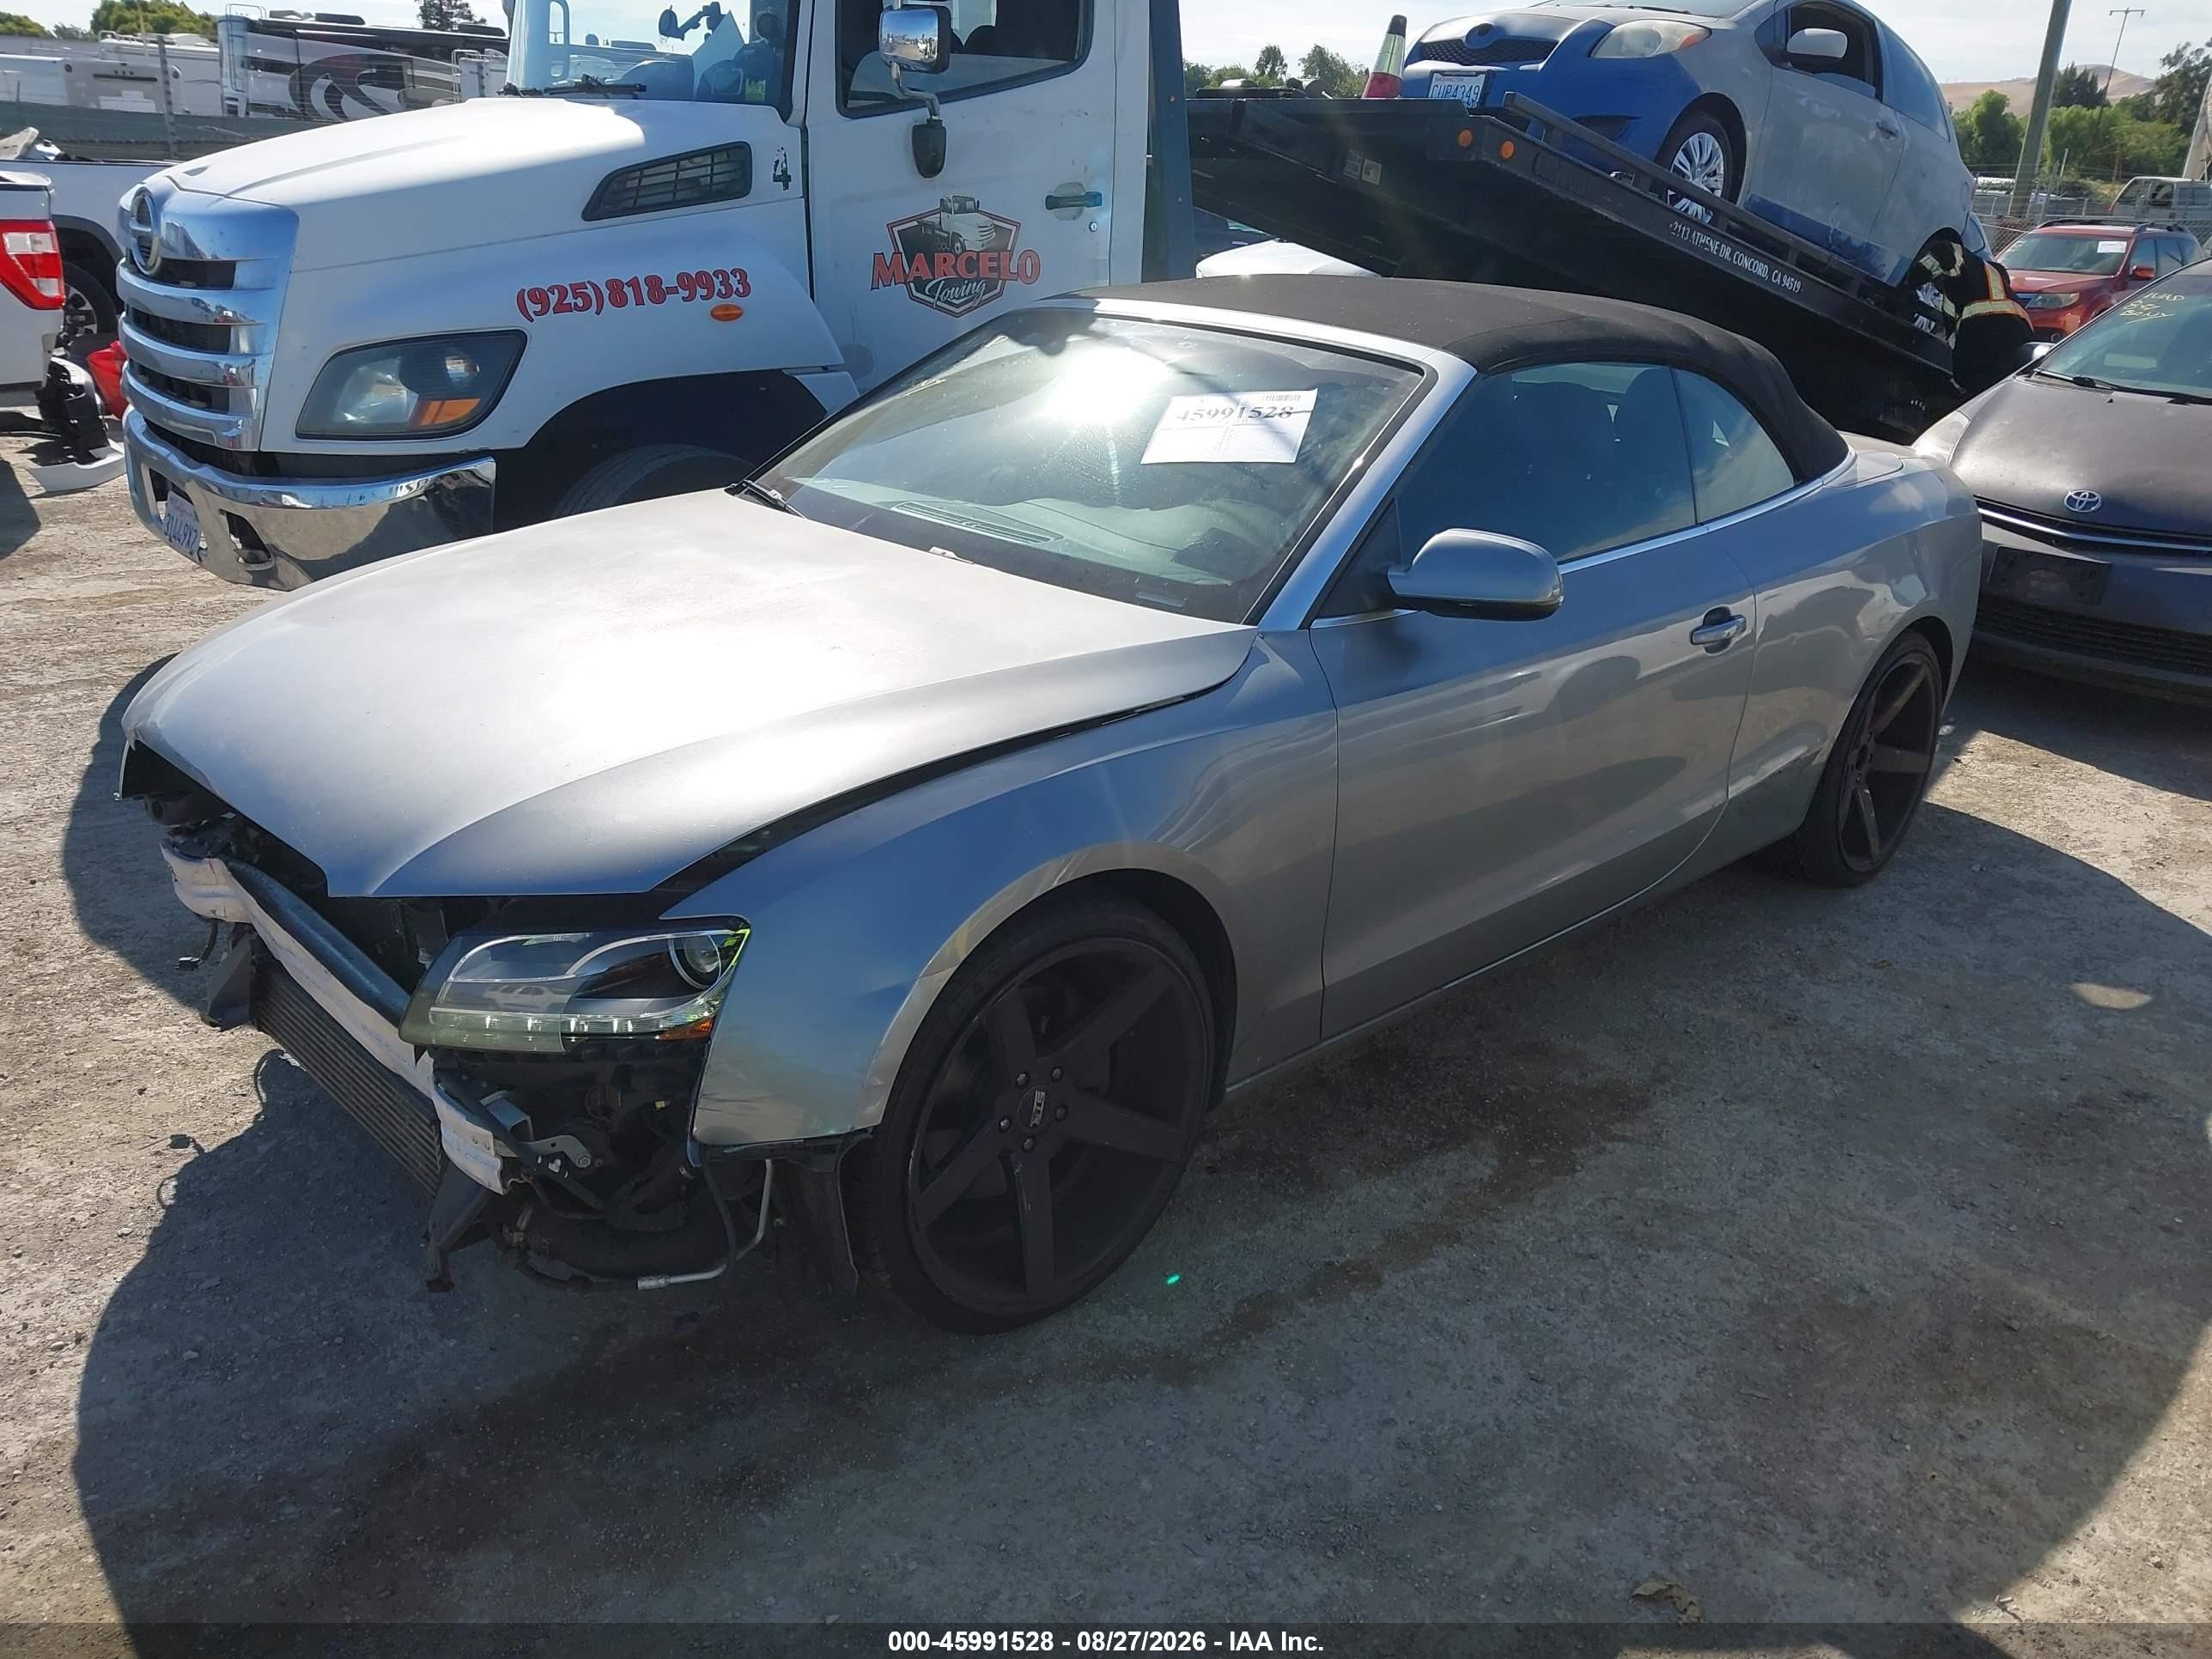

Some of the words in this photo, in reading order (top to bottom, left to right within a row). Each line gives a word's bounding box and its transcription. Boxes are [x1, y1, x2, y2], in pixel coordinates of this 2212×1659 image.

[773, 145, 792, 191] 4
[871, 249, 1041, 291] MARCELO
[1671, 221, 1691, 240] 2113
[1733, 251, 1769, 280] CONCORD,
[1771, 270, 1781, 285] CA
[1781, 274, 1802, 294] 94519
[925, 276, 987, 308] Towing
[1176, 405, 1293, 422] 45991528
